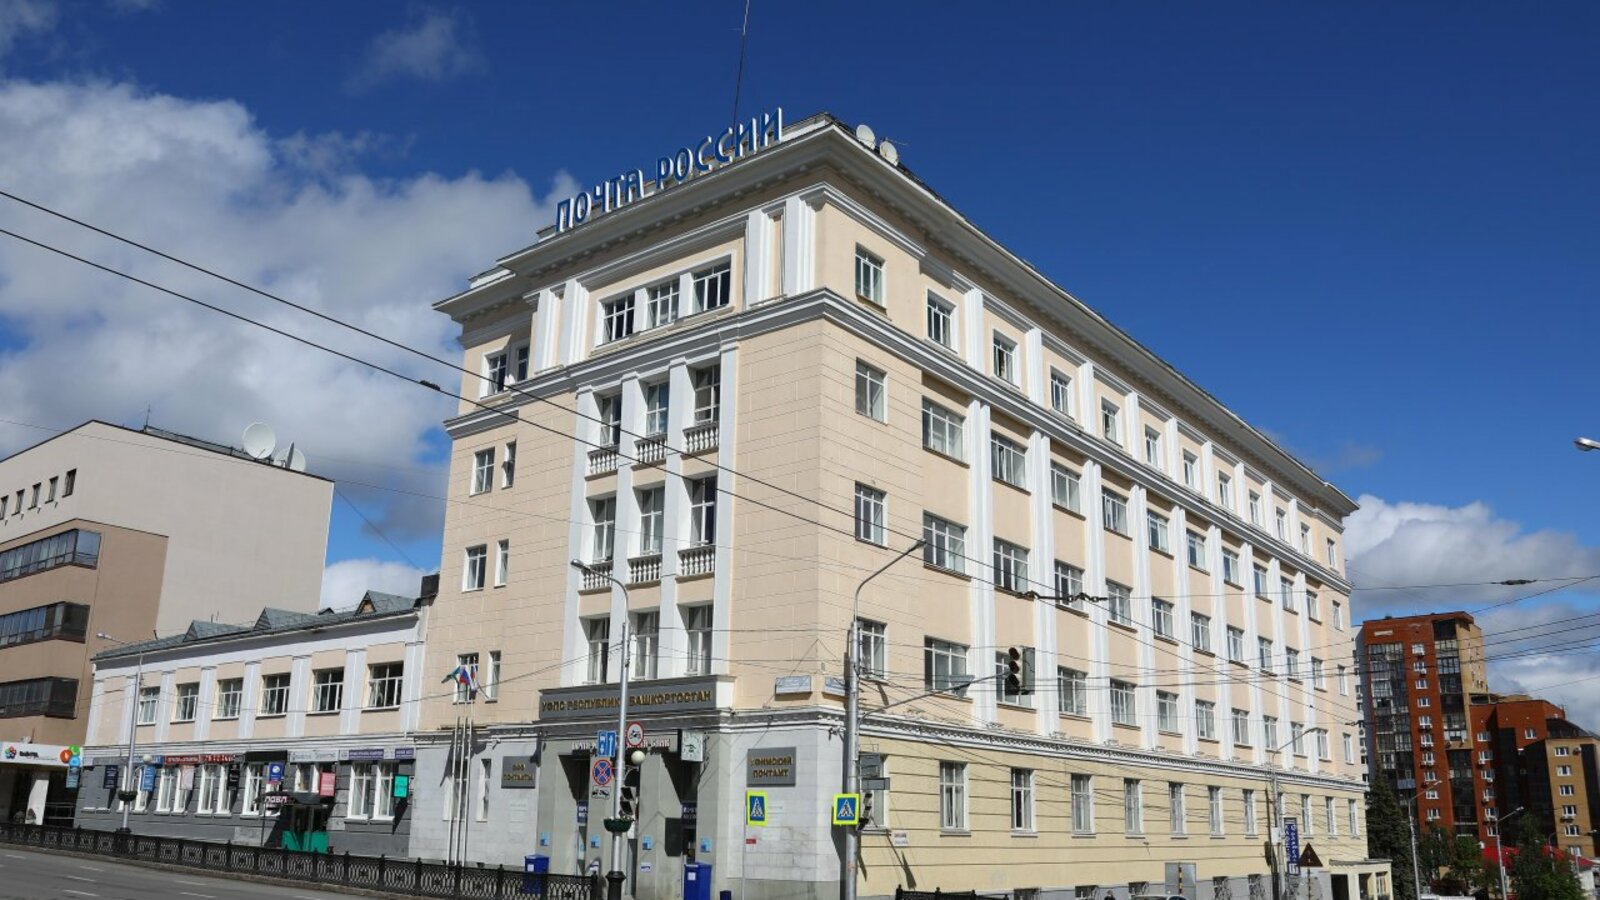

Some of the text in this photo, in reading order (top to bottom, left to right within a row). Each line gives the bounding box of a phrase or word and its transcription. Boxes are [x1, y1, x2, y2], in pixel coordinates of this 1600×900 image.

[556, 107, 783, 232] ПОЧТА РОССИИ
[567, 696, 621, 711] РЕСПУБЛИК
[629, 690, 711, 706] БАШКОРТОСТАН
[753, 768, 789, 778] ПОЧТАМТ
